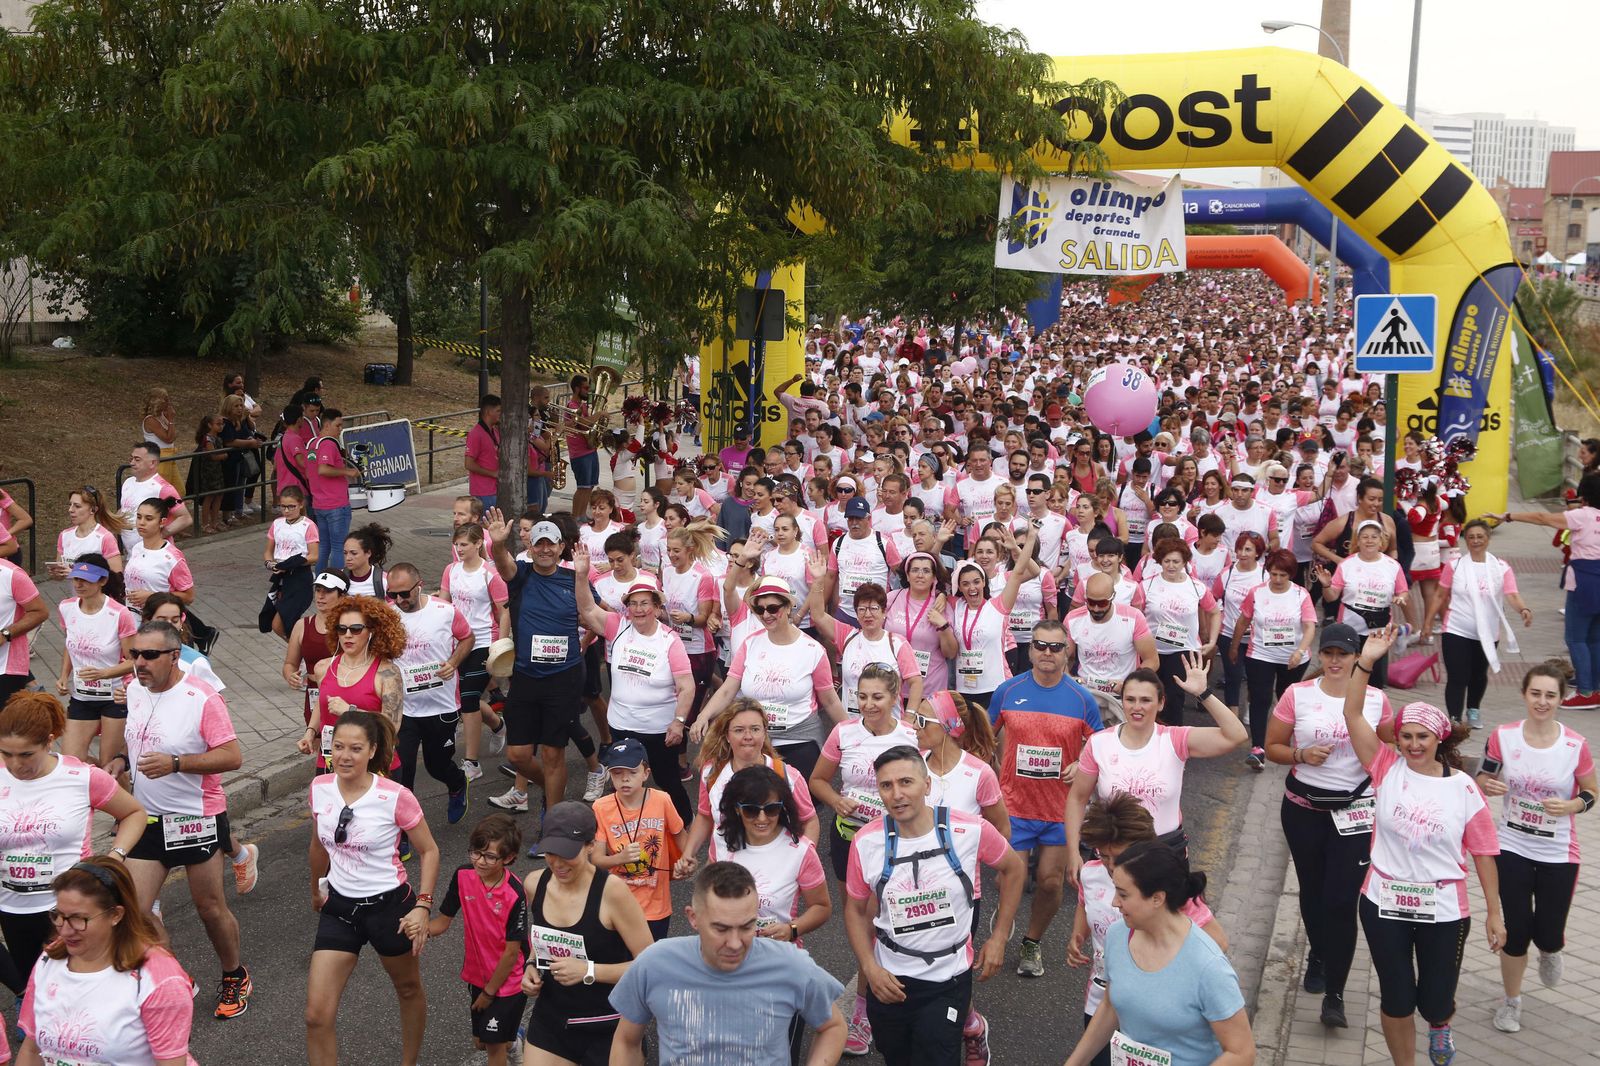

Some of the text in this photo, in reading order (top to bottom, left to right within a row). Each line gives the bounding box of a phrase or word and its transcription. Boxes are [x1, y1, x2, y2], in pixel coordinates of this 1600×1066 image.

[1070, 182, 1167, 218] olimpo
[1182, 201, 1199, 215] ia
[1065, 209, 1131, 226] deportes
[1093, 226, 1141, 240] Granada
[1059, 238, 1180, 271] SALIDA
[1453, 303, 1479, 372] olimpo
[1482, 361, 1495, 379] TRAIL
[1491, 314, 1506, 350] RUNNING
[1466, 333, 1482, 377] deportes
[1122, 368, 1143, 391] 38
[369, 454, 413, 479] GRANADA
[542, 645, 561, 654] 3665
[628, 655, 646, 666] 3670
[413, 672, 432, 683] 8531
[1025, 748, 1061, 757] COVIRAN
[1028, 757, 1051, 768] 8840
[1518, 800, 1545, 813] COVIR
[1346, 809, 1370, 822] 7882
[1520, 810, 1543, 825] 7391
[178, 822, 203, 835] 7420
[5, 854, 53, 865] COVIRAN
[9, 866, 36, 879] 8279
[1390, 883, 1435, 895] COVIRAN
[898, 890, 947, 905] COVIRAN
[1395, 894, 1421, 908] 7883
[904, 902, 936, 919] 2930
[541, 933, 583, 948] COVIRAN
[1120, 1043, 1169, 1065] COVIRAN
